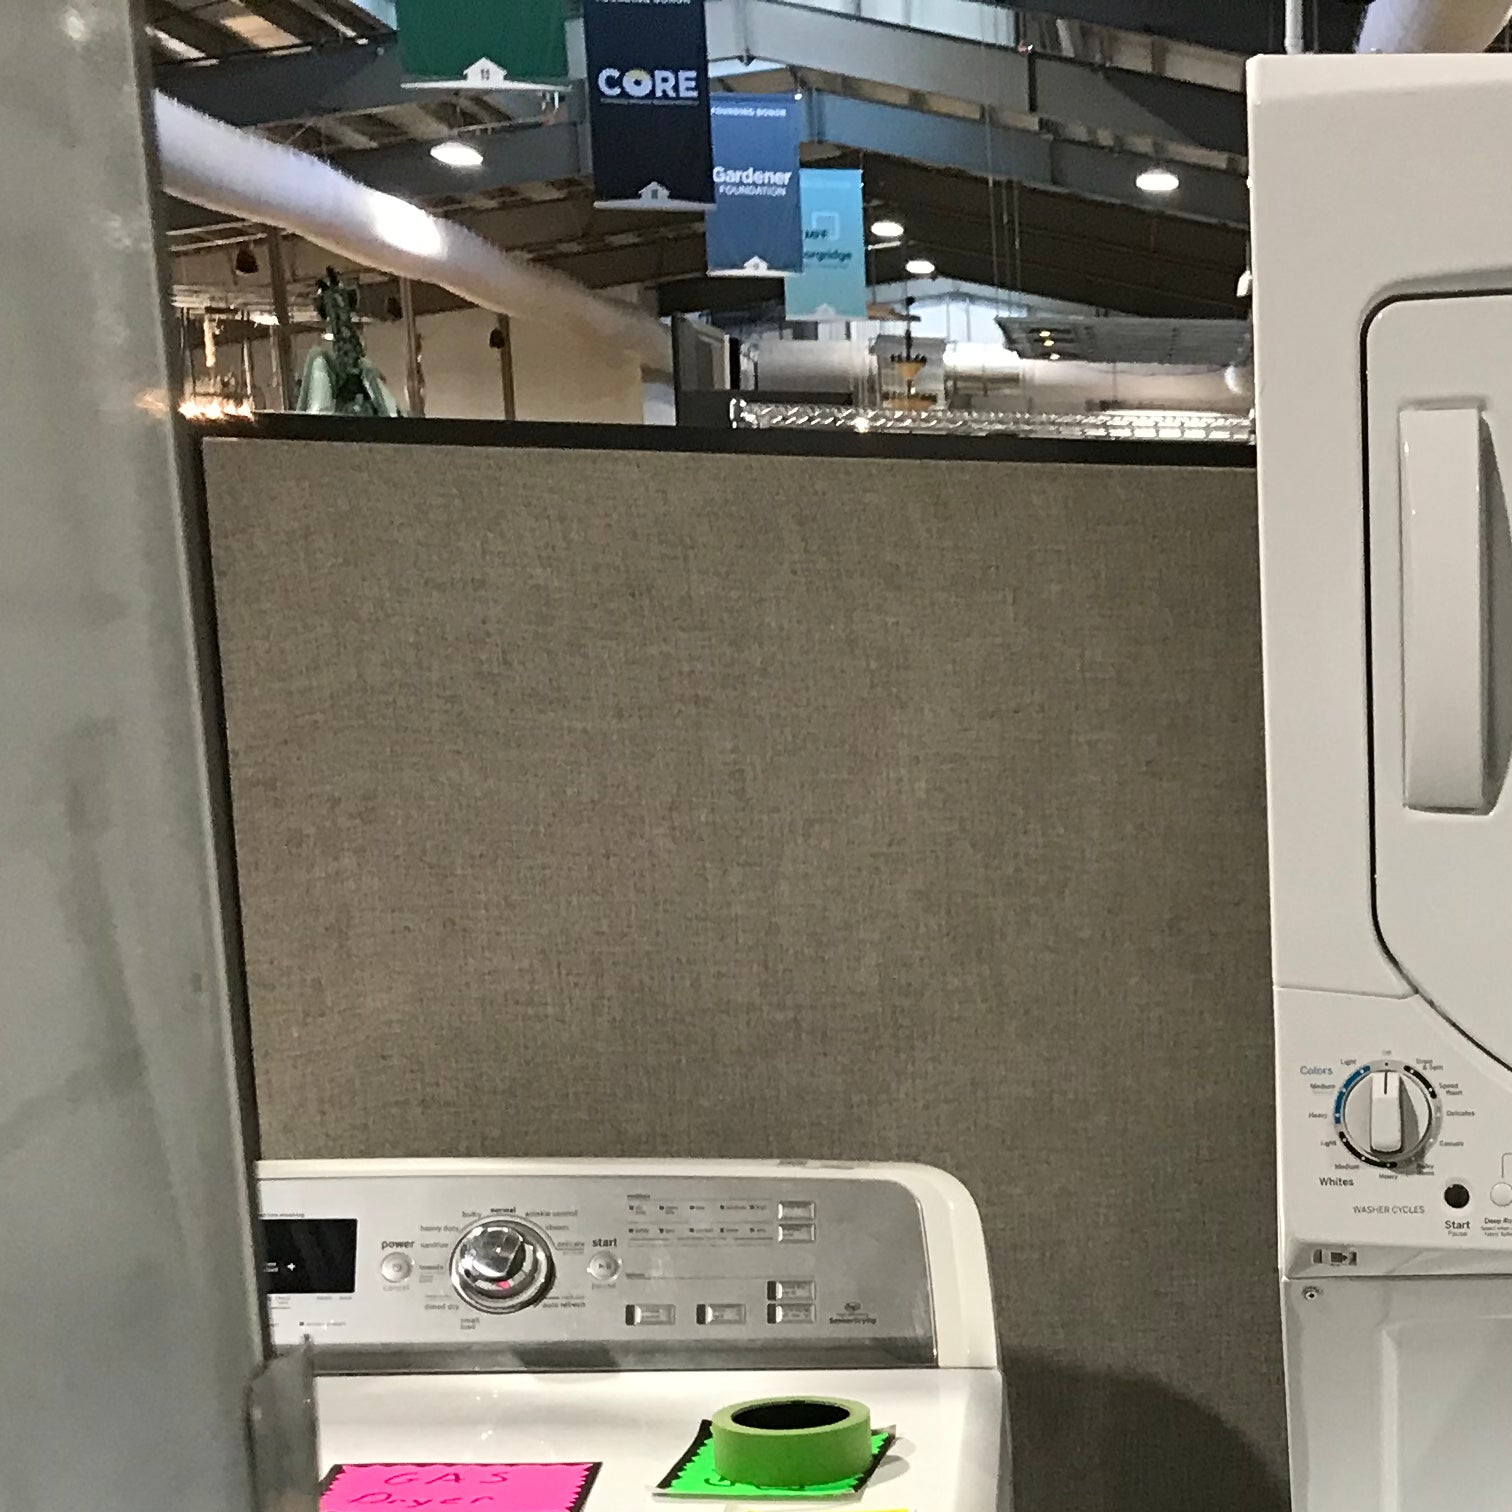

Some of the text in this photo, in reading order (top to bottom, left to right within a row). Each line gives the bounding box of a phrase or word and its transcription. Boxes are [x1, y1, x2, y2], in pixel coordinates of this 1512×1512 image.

[598, 67, 698, 97] CORE
[713, 166, 792, 185] Gardener
[719, 185, 786, 196] FOUNDATION
[1299, 1065, 1334, 1075] Colors
[1319, 1176, 1355, 1187] Whites
[1352, 1204, 1426, 1214] WASHER CYCLES
[1445, 1219, 1471, 1230] Start
[381, 1240, 415, 1250] power
[592, 1238, 618, 1248] start
[384, 1471, 509, 1486] GAS
